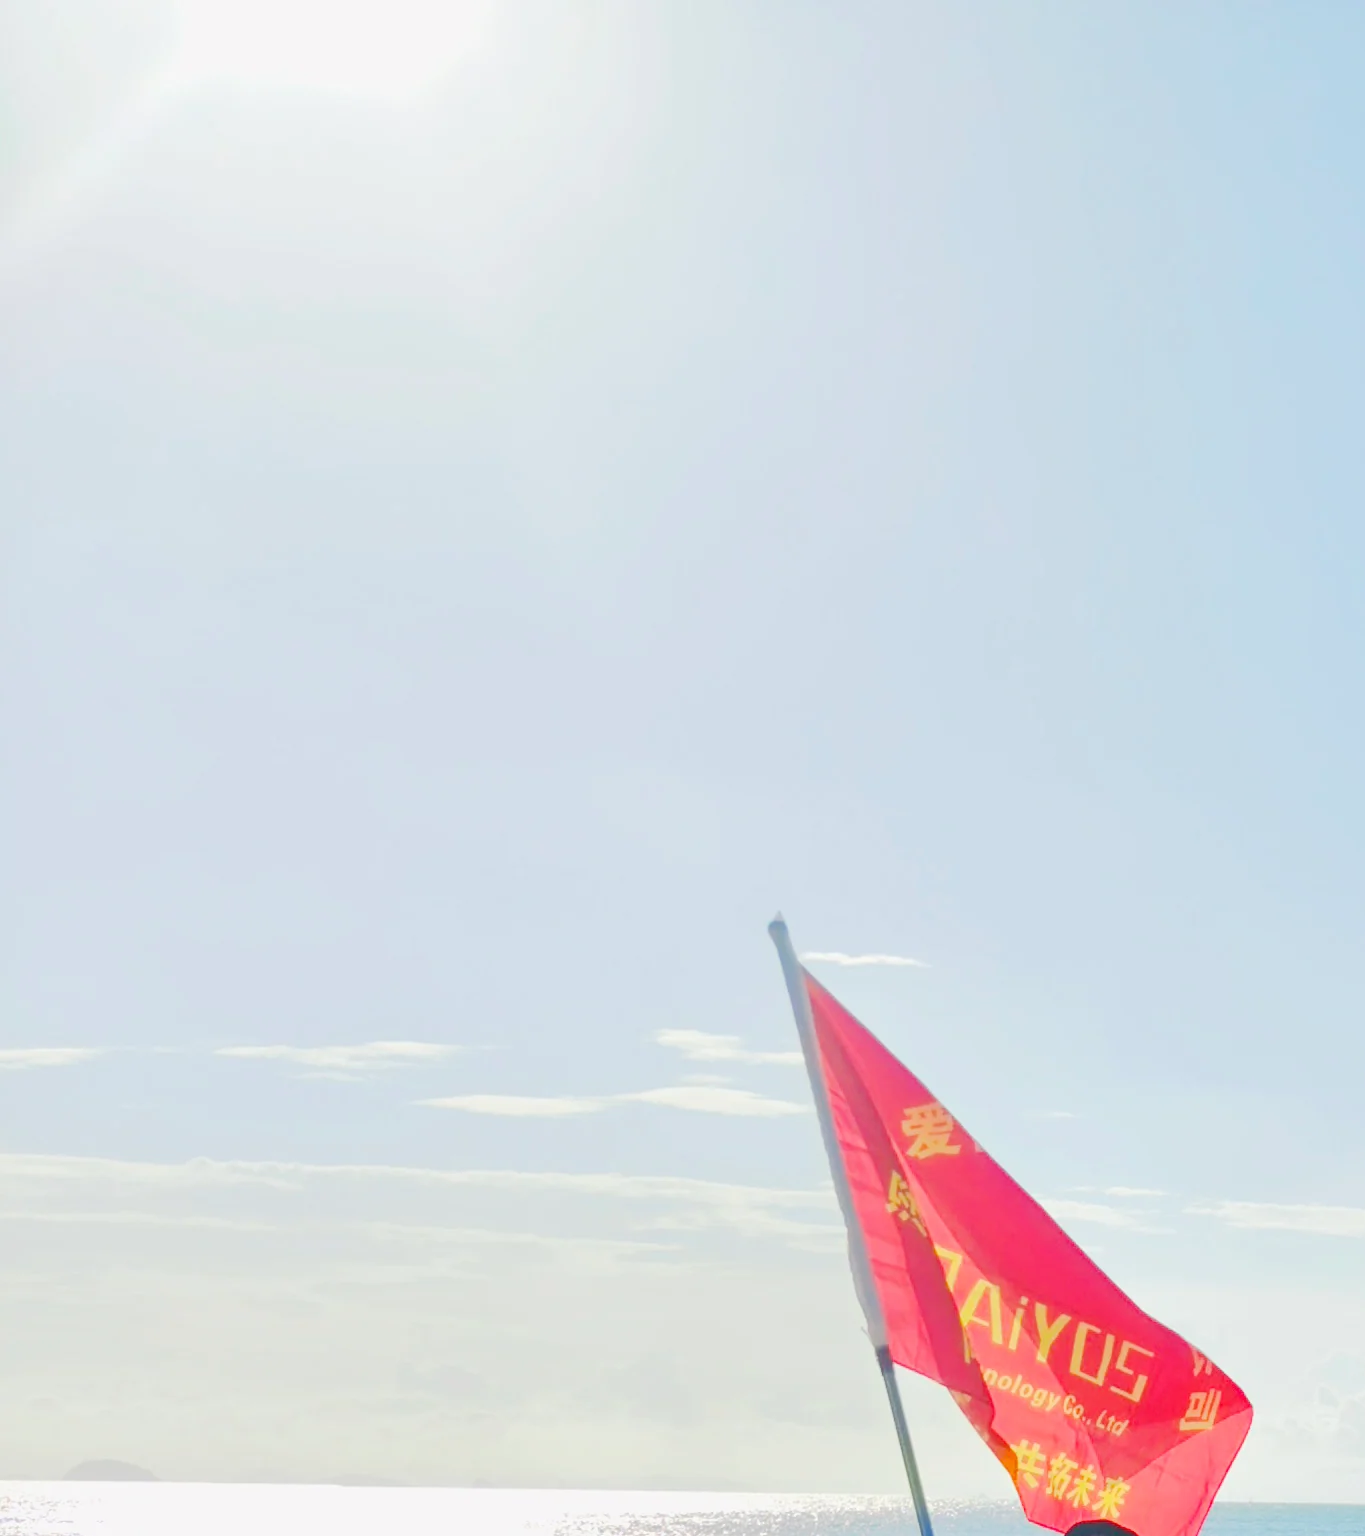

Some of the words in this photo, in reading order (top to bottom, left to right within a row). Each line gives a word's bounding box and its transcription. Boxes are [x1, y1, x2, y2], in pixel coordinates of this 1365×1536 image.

[983, 1366, 1061, 1413] nology
[1095, 1409, 1130, 1437] Ltd
[1010, 1438, 1131, 1519] 共拓未来
